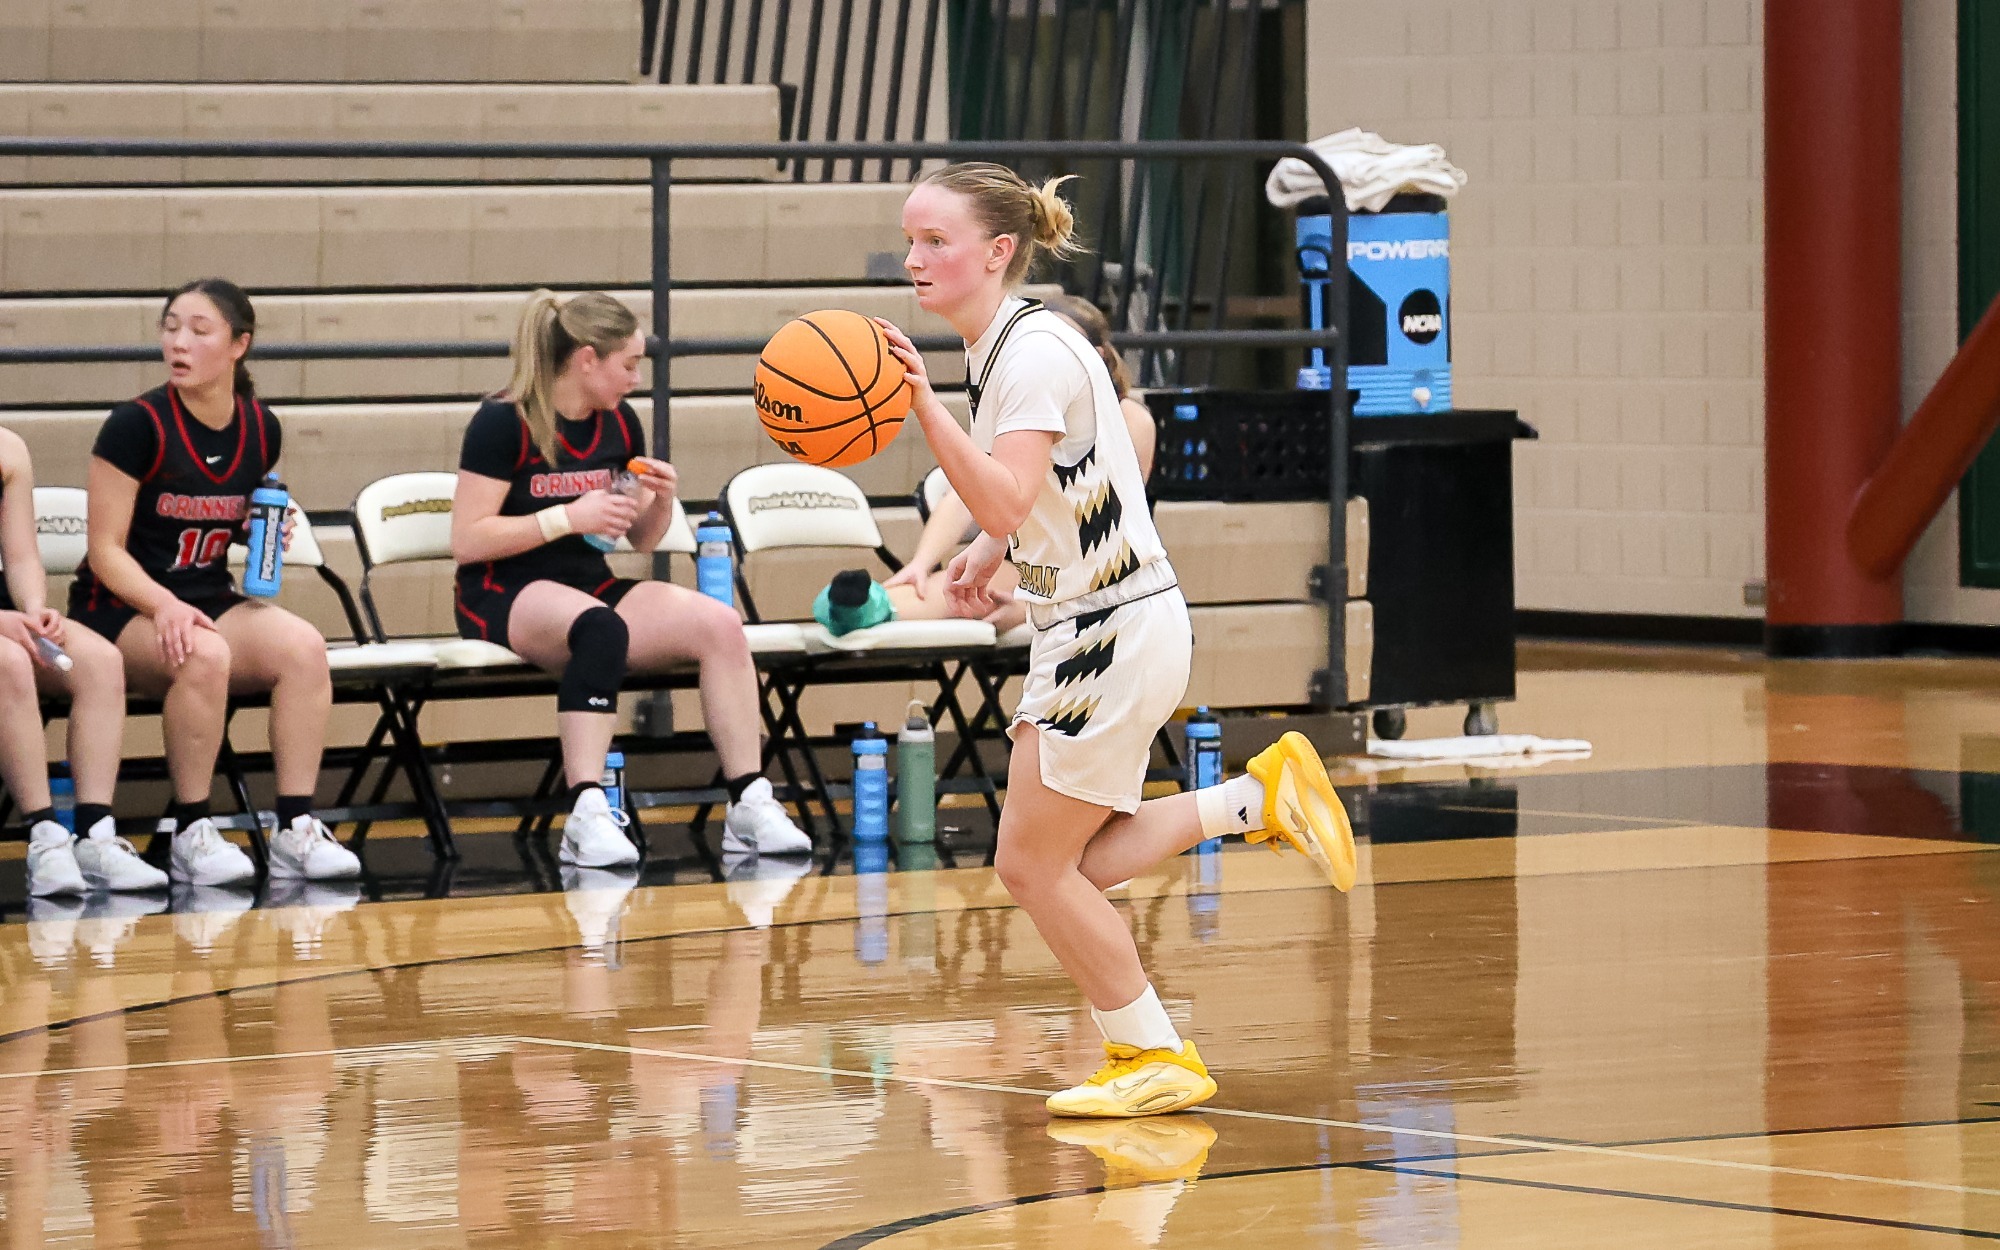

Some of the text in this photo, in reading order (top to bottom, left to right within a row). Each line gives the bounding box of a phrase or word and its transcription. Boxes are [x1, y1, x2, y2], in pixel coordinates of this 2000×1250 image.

[754, 379, 803, 423] ilson
[156, 492, 246, 520] GRINNE
[167, 527, 233, 573] 10
